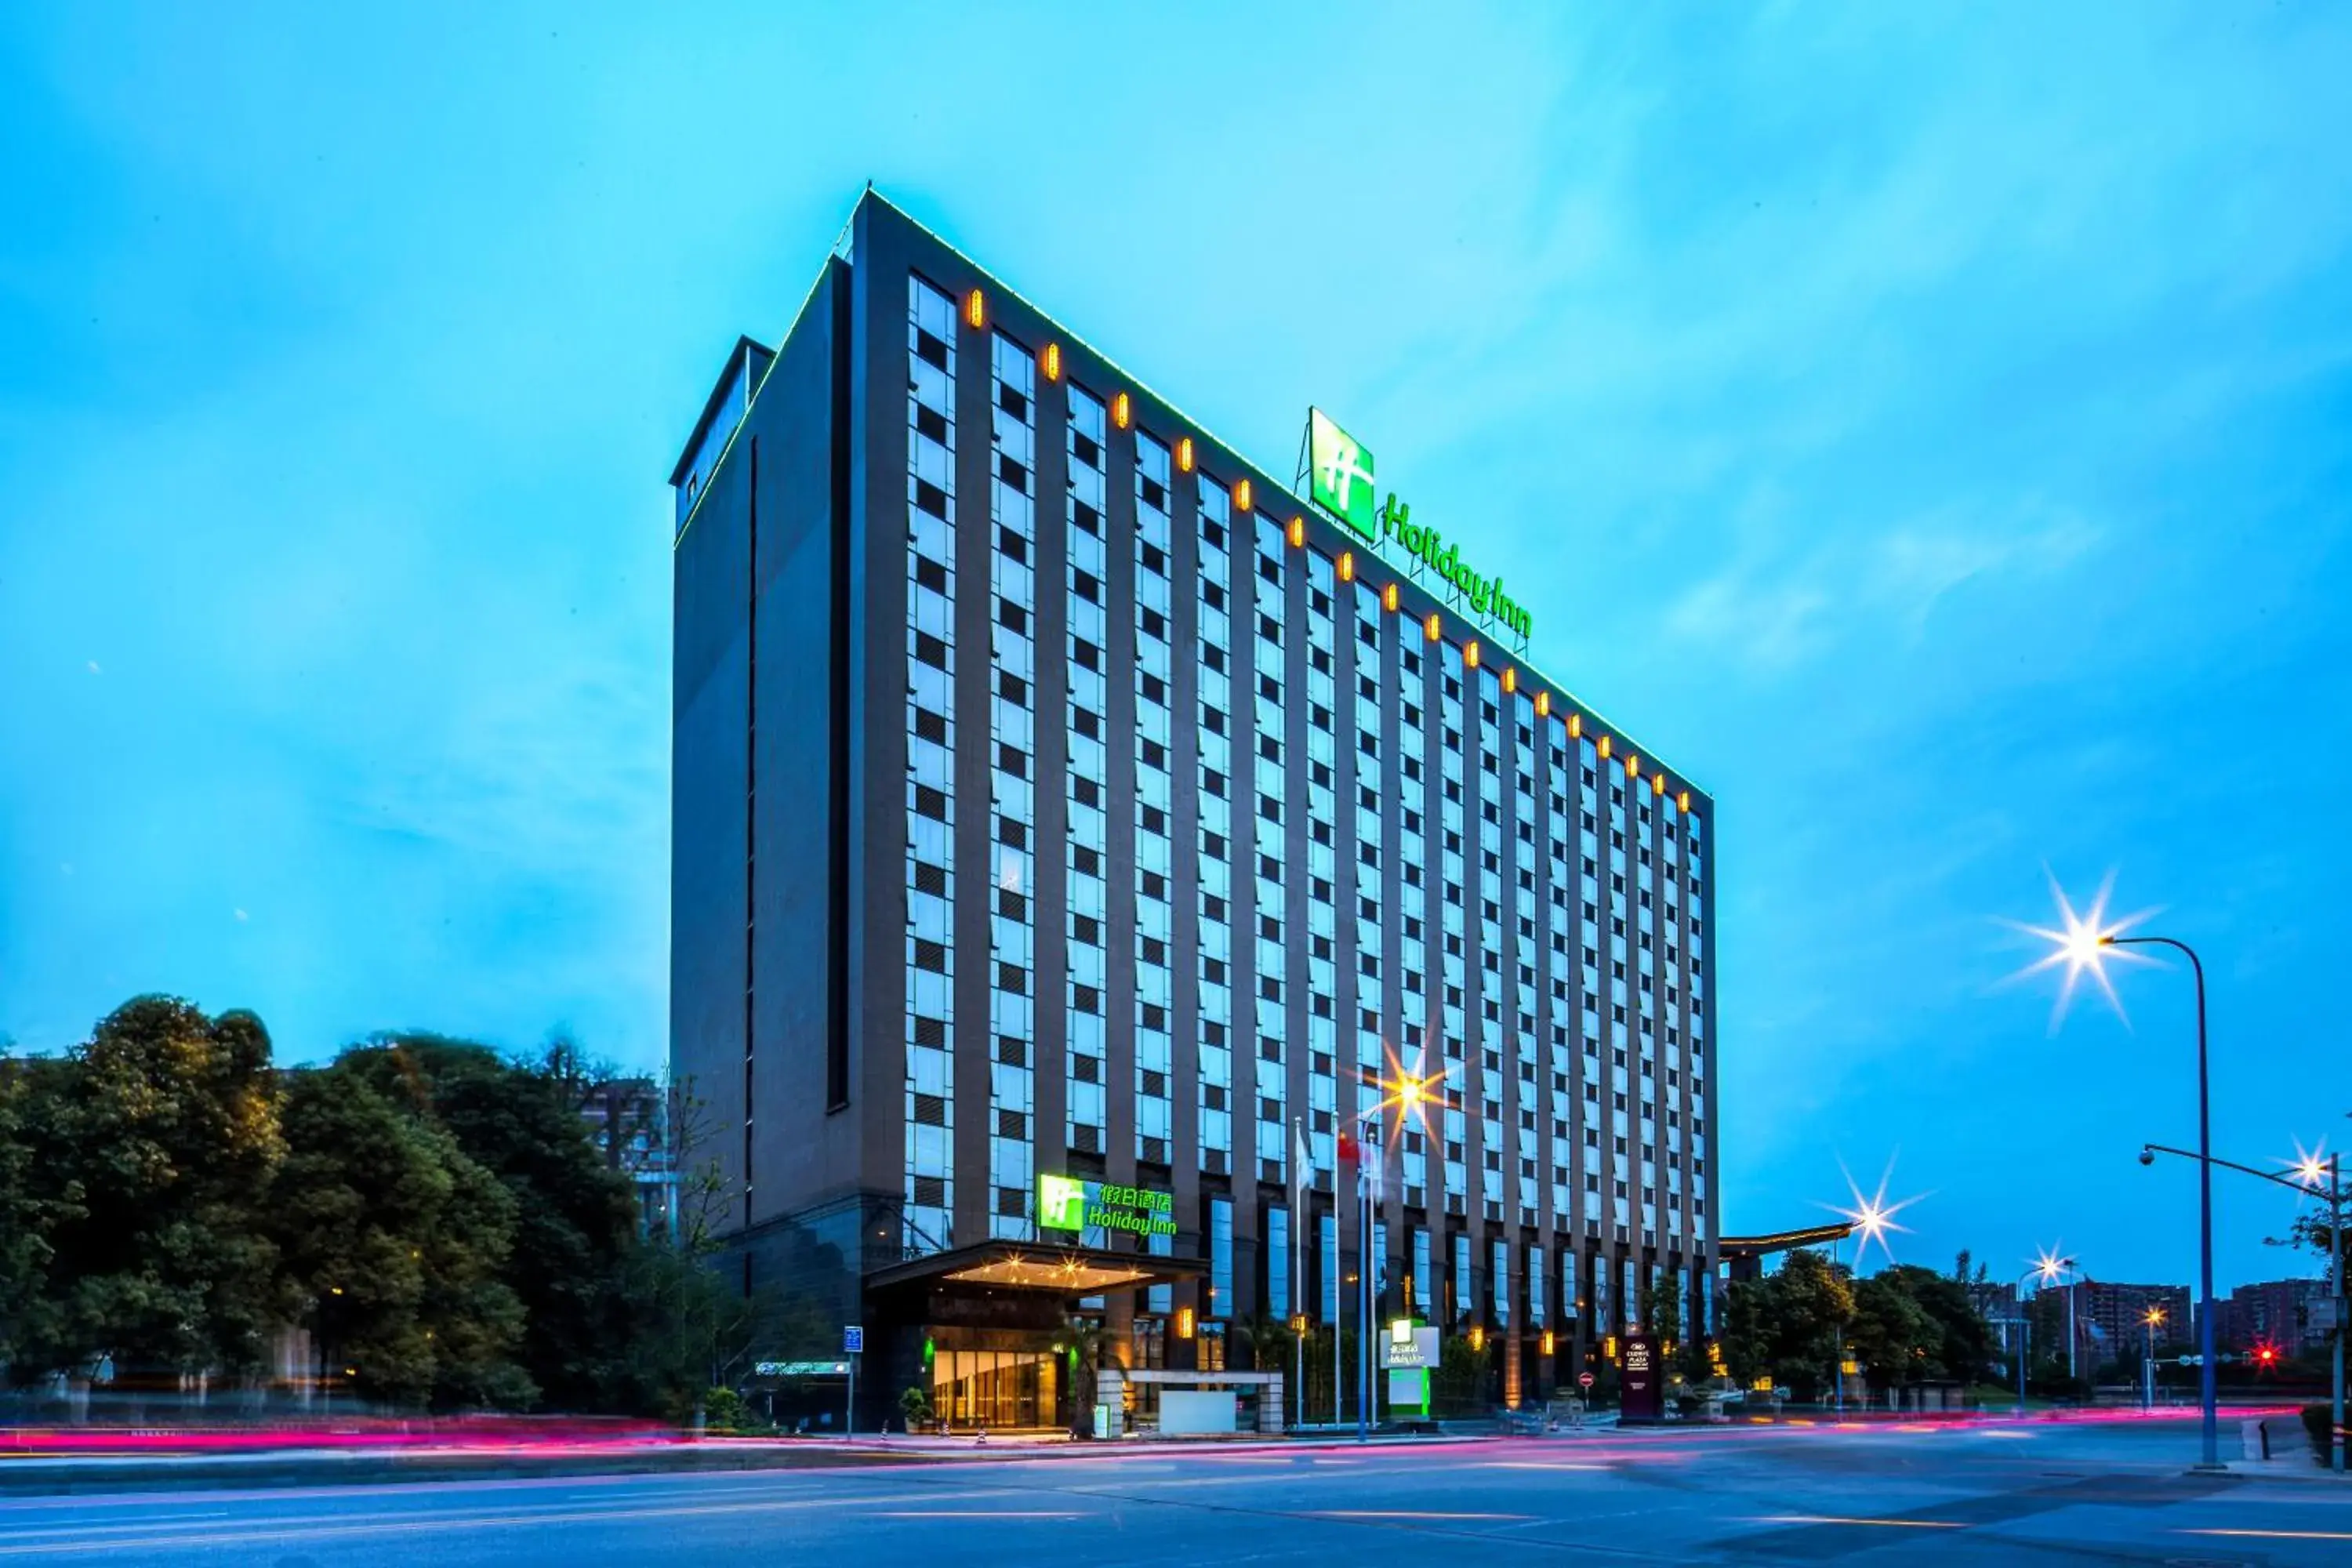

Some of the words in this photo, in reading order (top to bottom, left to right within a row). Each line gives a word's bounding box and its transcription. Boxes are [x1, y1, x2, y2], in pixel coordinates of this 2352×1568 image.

[1385, 492, 1490, 613] Holiday
[1491, 577, 1532, 639] Inn
[1089, 1206, 1149, 1236] Holiday
[1152, 1214, 1177, 1236] Inn
